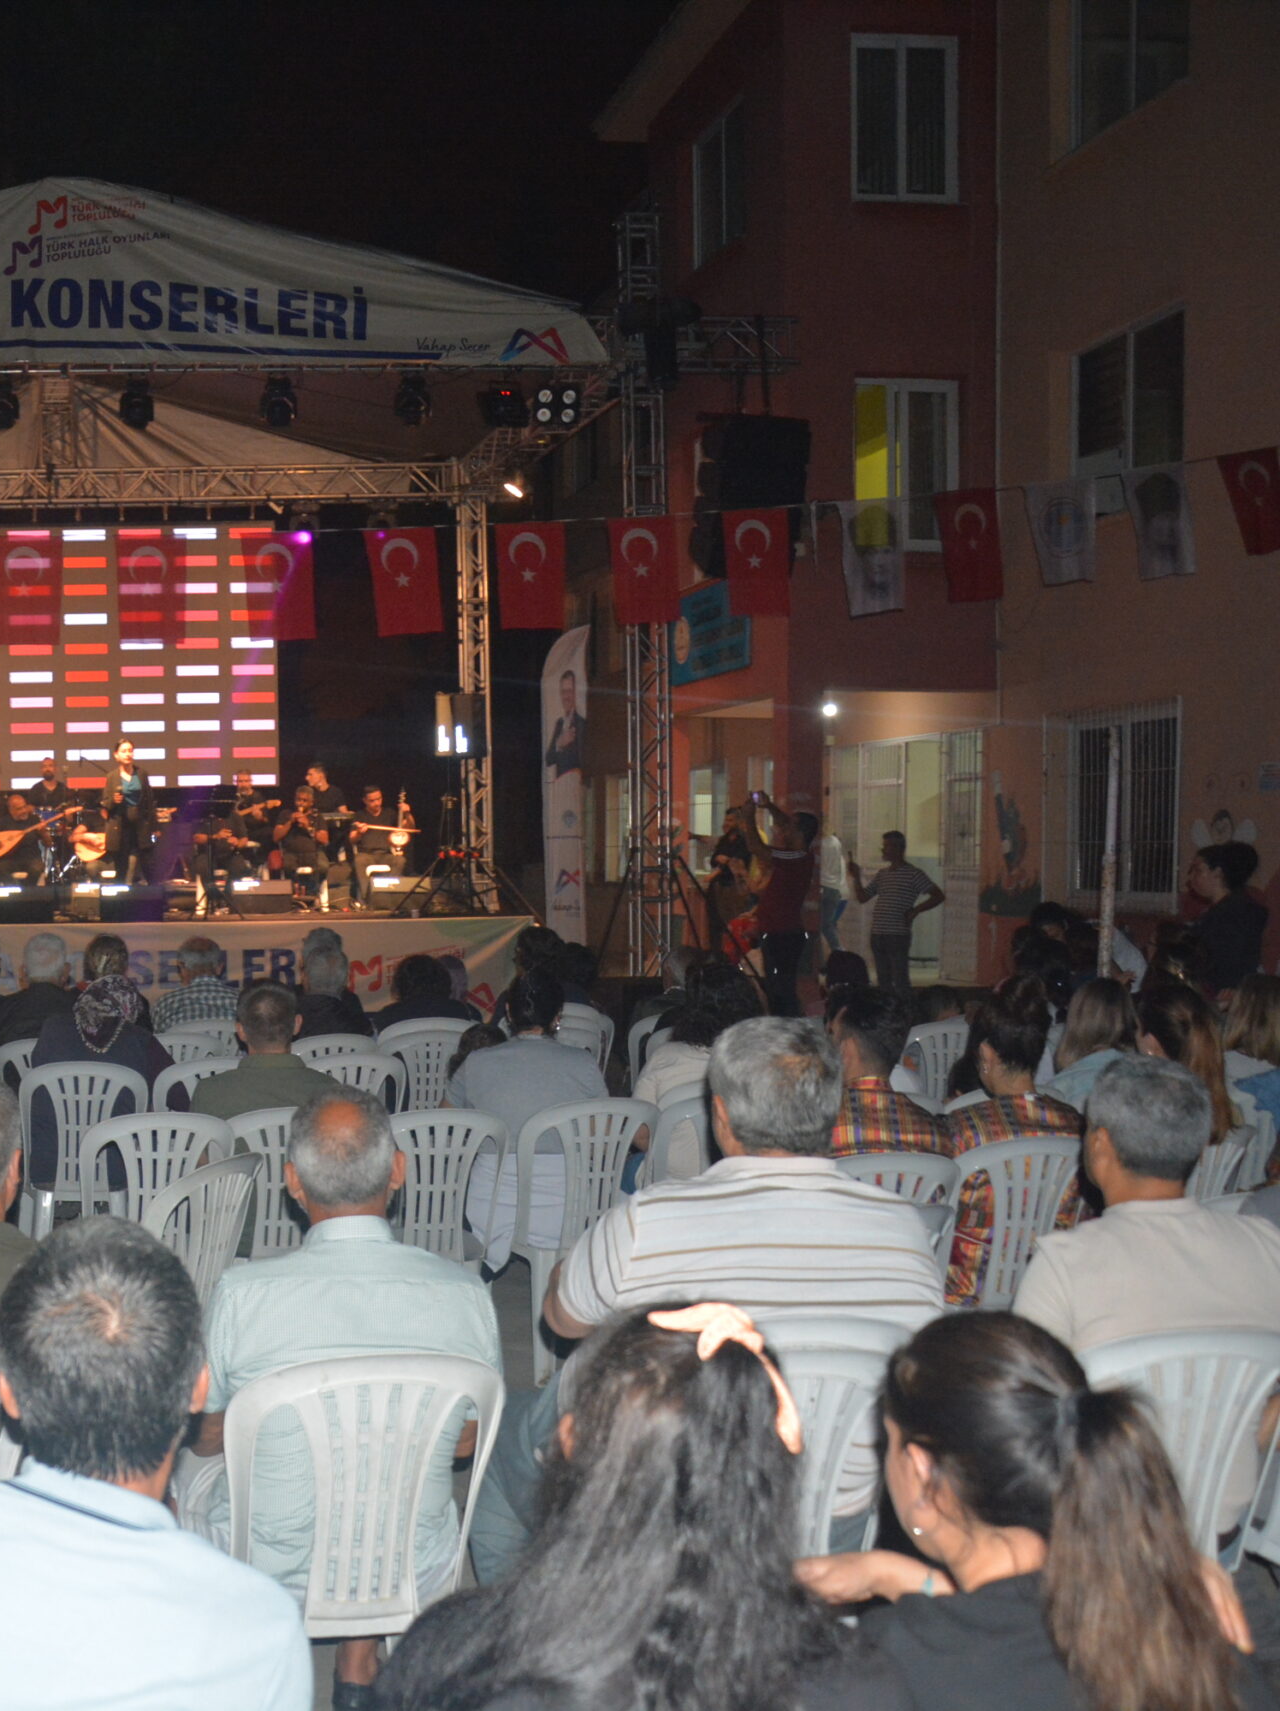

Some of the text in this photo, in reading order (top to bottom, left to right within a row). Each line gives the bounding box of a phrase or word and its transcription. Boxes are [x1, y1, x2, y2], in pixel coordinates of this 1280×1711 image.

[46, 239, 75, 252] TÜRK
[78, 235, 109, 248] HALK
[113, 231, 171, 244] OYUNLARI
[46, 245, 112, 263] TOPLULUĞU
[10, 278, 368, 341] KONSERLERİ
[416, 336, 457, 357] Vahap
